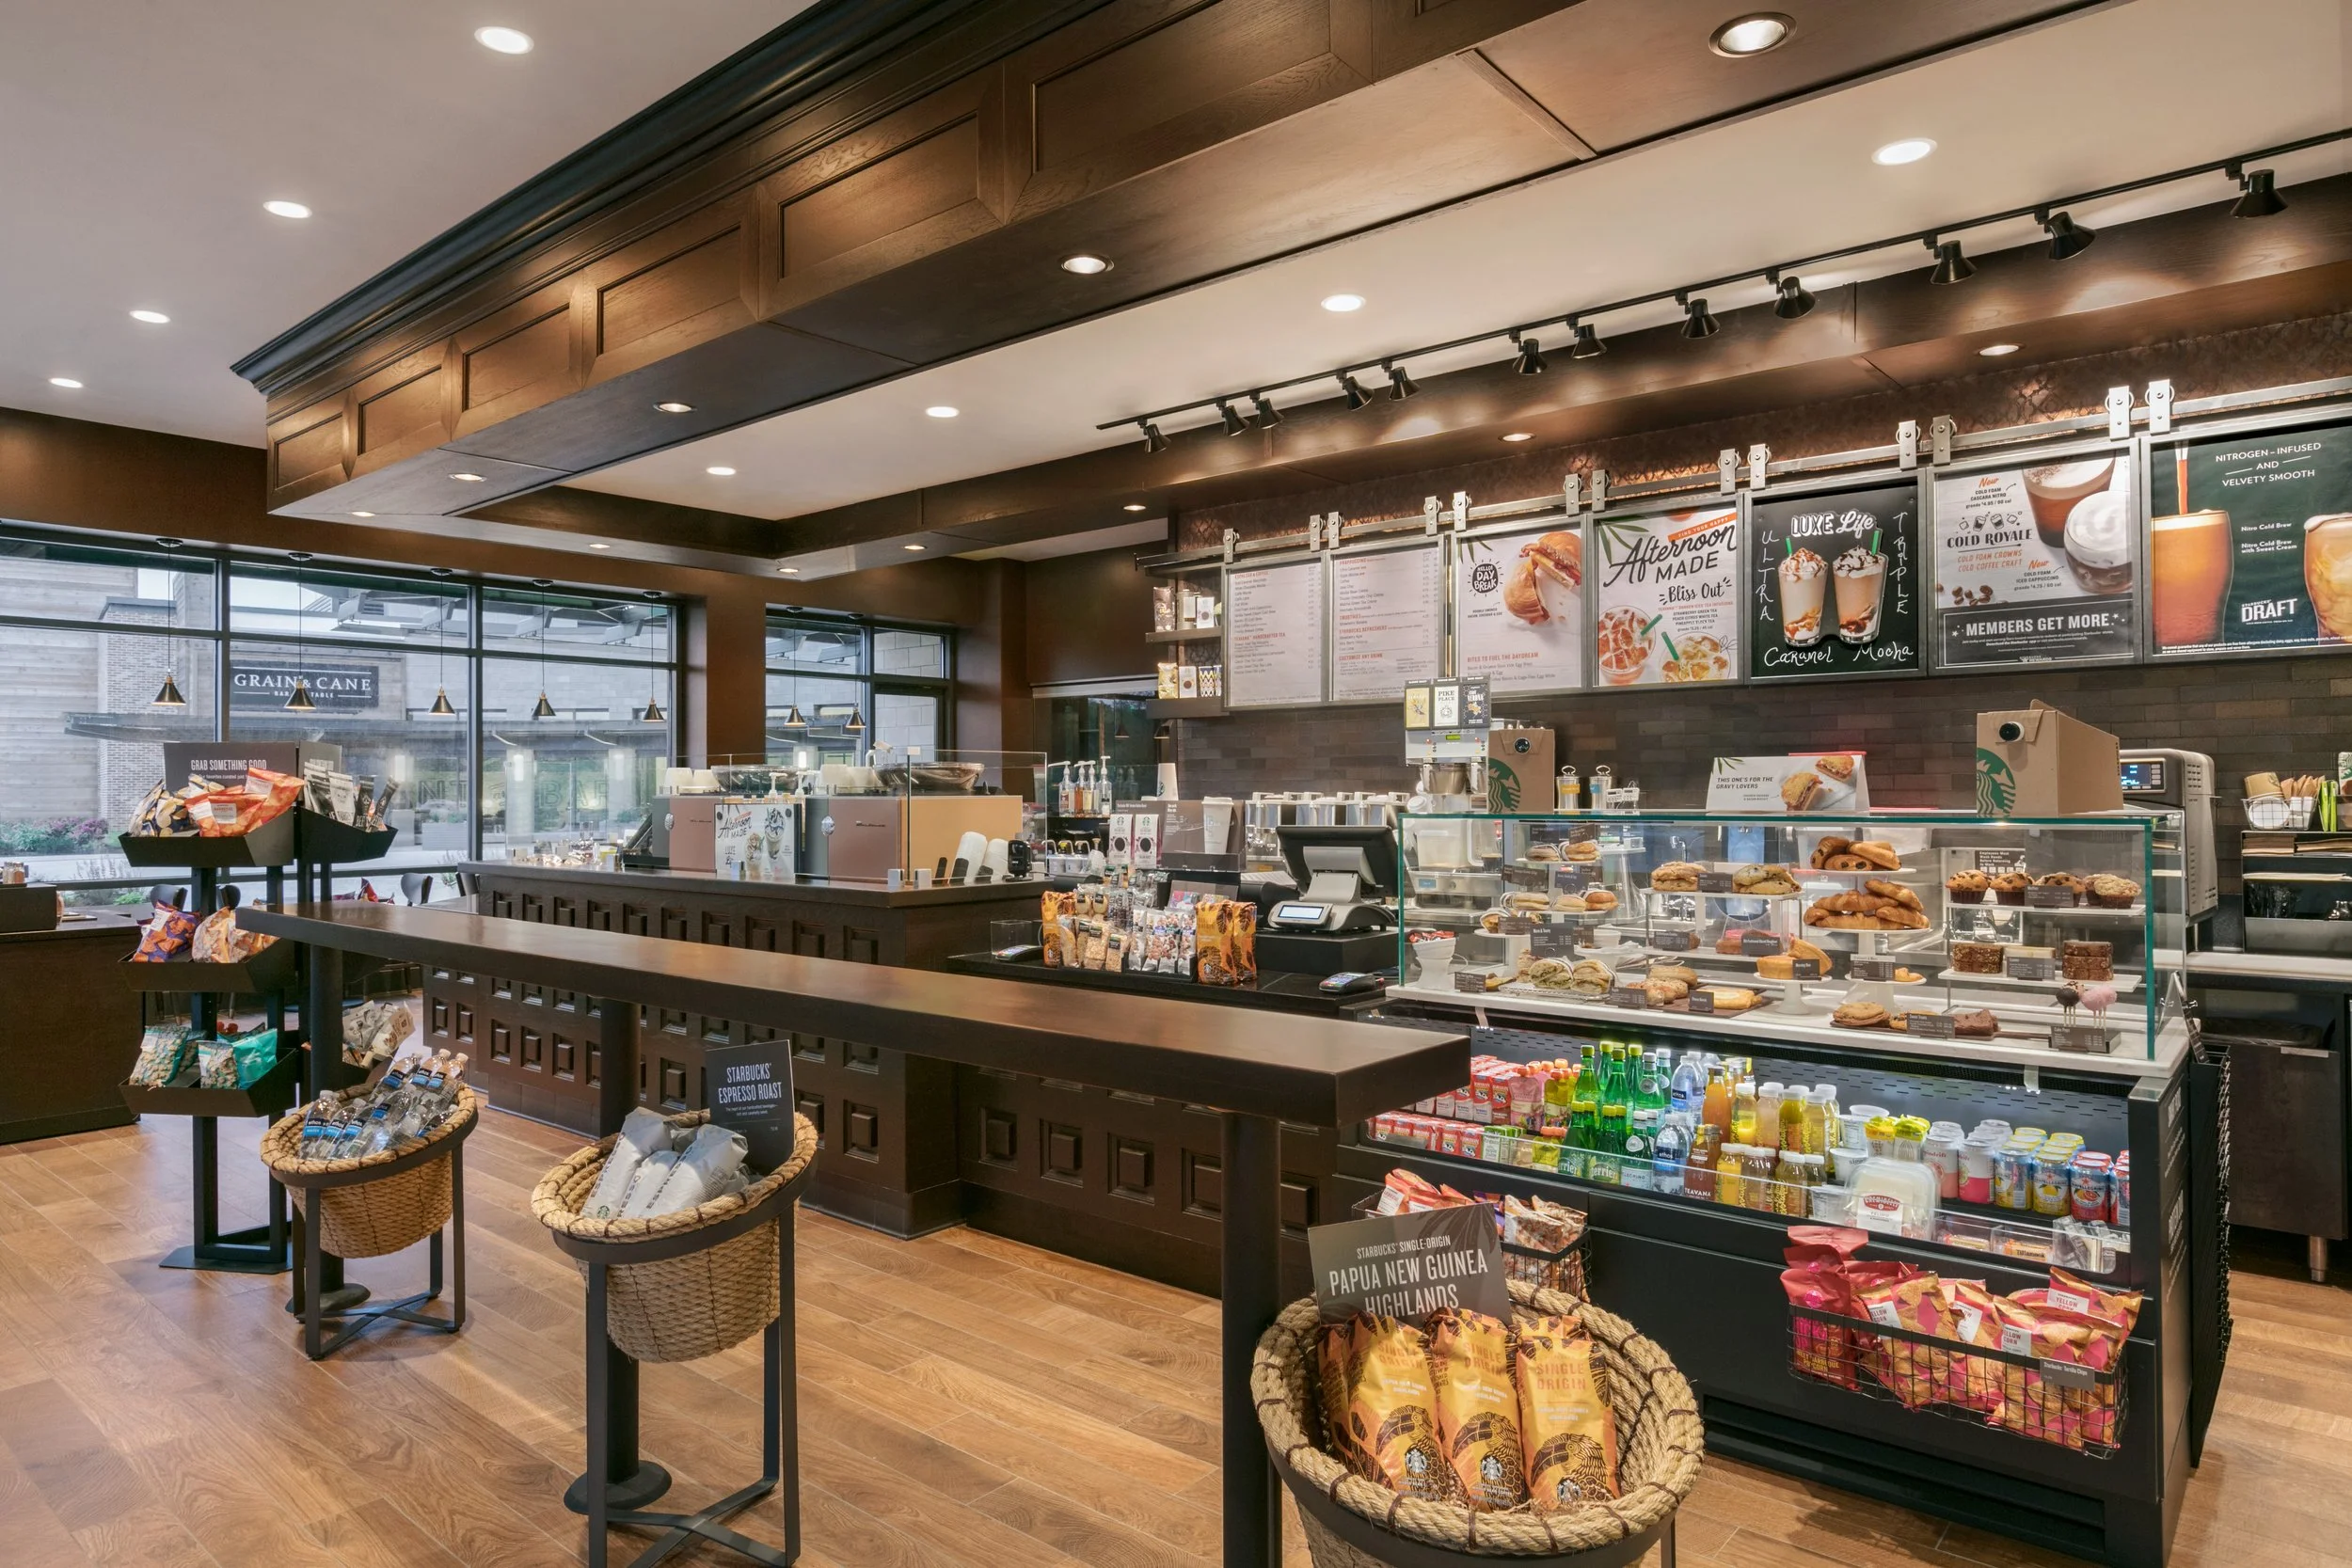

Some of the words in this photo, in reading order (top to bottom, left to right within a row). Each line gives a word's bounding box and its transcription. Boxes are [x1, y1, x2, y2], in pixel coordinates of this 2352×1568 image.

[2215, 449, 2268, 463] NITROGEN
[2277, 442, 2322, 455] INFUSED
[2256, 460, 2280, 470] AND
[1979, 477, 1999, 488] New
[2222, 475, 2266, 487] VELVETY
[2268, 469, 2315, 482] SMOOTH
[1693, 524, 1708, 533] YOUR
[1709, 516, 1728, 528] HAPPY
[1790, 512, 1835, 538] LUXE
[1836, 510, 1875, 539] Life
[1947, 533, 1980, 548] COLD
[1985, 528, 2032, 546] ROYALE
[1603, 524, 1737, 587] Afternoon
[1957, 555, 1974, 563] COLD
[1994, 549, 2023, 560] CROWNS
[1655, 550, 1719, 584] MADE
[1976, 562, 2000, 570] COFFEE
[2002, 559, 2023, 568] CRAFT
[2028, 560, 2049, 570] New
[1476, 570, 1495, 581] DAY
[1474, 579, 1497, 592] BREAK
[1668, 584, 1698, 603] Bliss
[1701, 582, 1725, 599] Out
[2241, 598, 2297, 623] DRAFT
[1965, 619, 2034, 637] MEMBERS
[2037, 616, 2064, 630] GET
[234, 673, 296, 688] GRAIN
[302, 679, 311, 688] &
[316, 676, 371, 690] CANE
[190, 759, 208, 770] GRAB
[209, 759, 247, 771] SOMETHING
[248, 759, 267, 770] GOOD
[726, 1063, 771, 1084] STARBUCKS
[718, 1084, 756, 1104] ESPRESSO
[758, 1082, 782, 1100] ROAST
[1685, 1187, 1711, 1196] TEAVANA
[1357, 1243, 1396, 1259] STARBUCKS
[1399, 1235, 1451, 1253] SINGLE-ORIGIN
[2016, 1249, 2045, 1258] Tillamook
[1329, 1263, 1382, 1296] PAPUA
[1385, 1258, 1421, 1286] NEW
[1425, 1248, 1488, 1280] GUINEA
[1365, 1283, 1459, 1318] HIGHLANDS
[2056, 1296, 2078, 1308] YELLOW
[1537, 1362, 1584, 1374] SINGLE
[2076, 1367, 2088, 1376] Chips
[1537, 1378, 1586, 1390] ORIGIN
